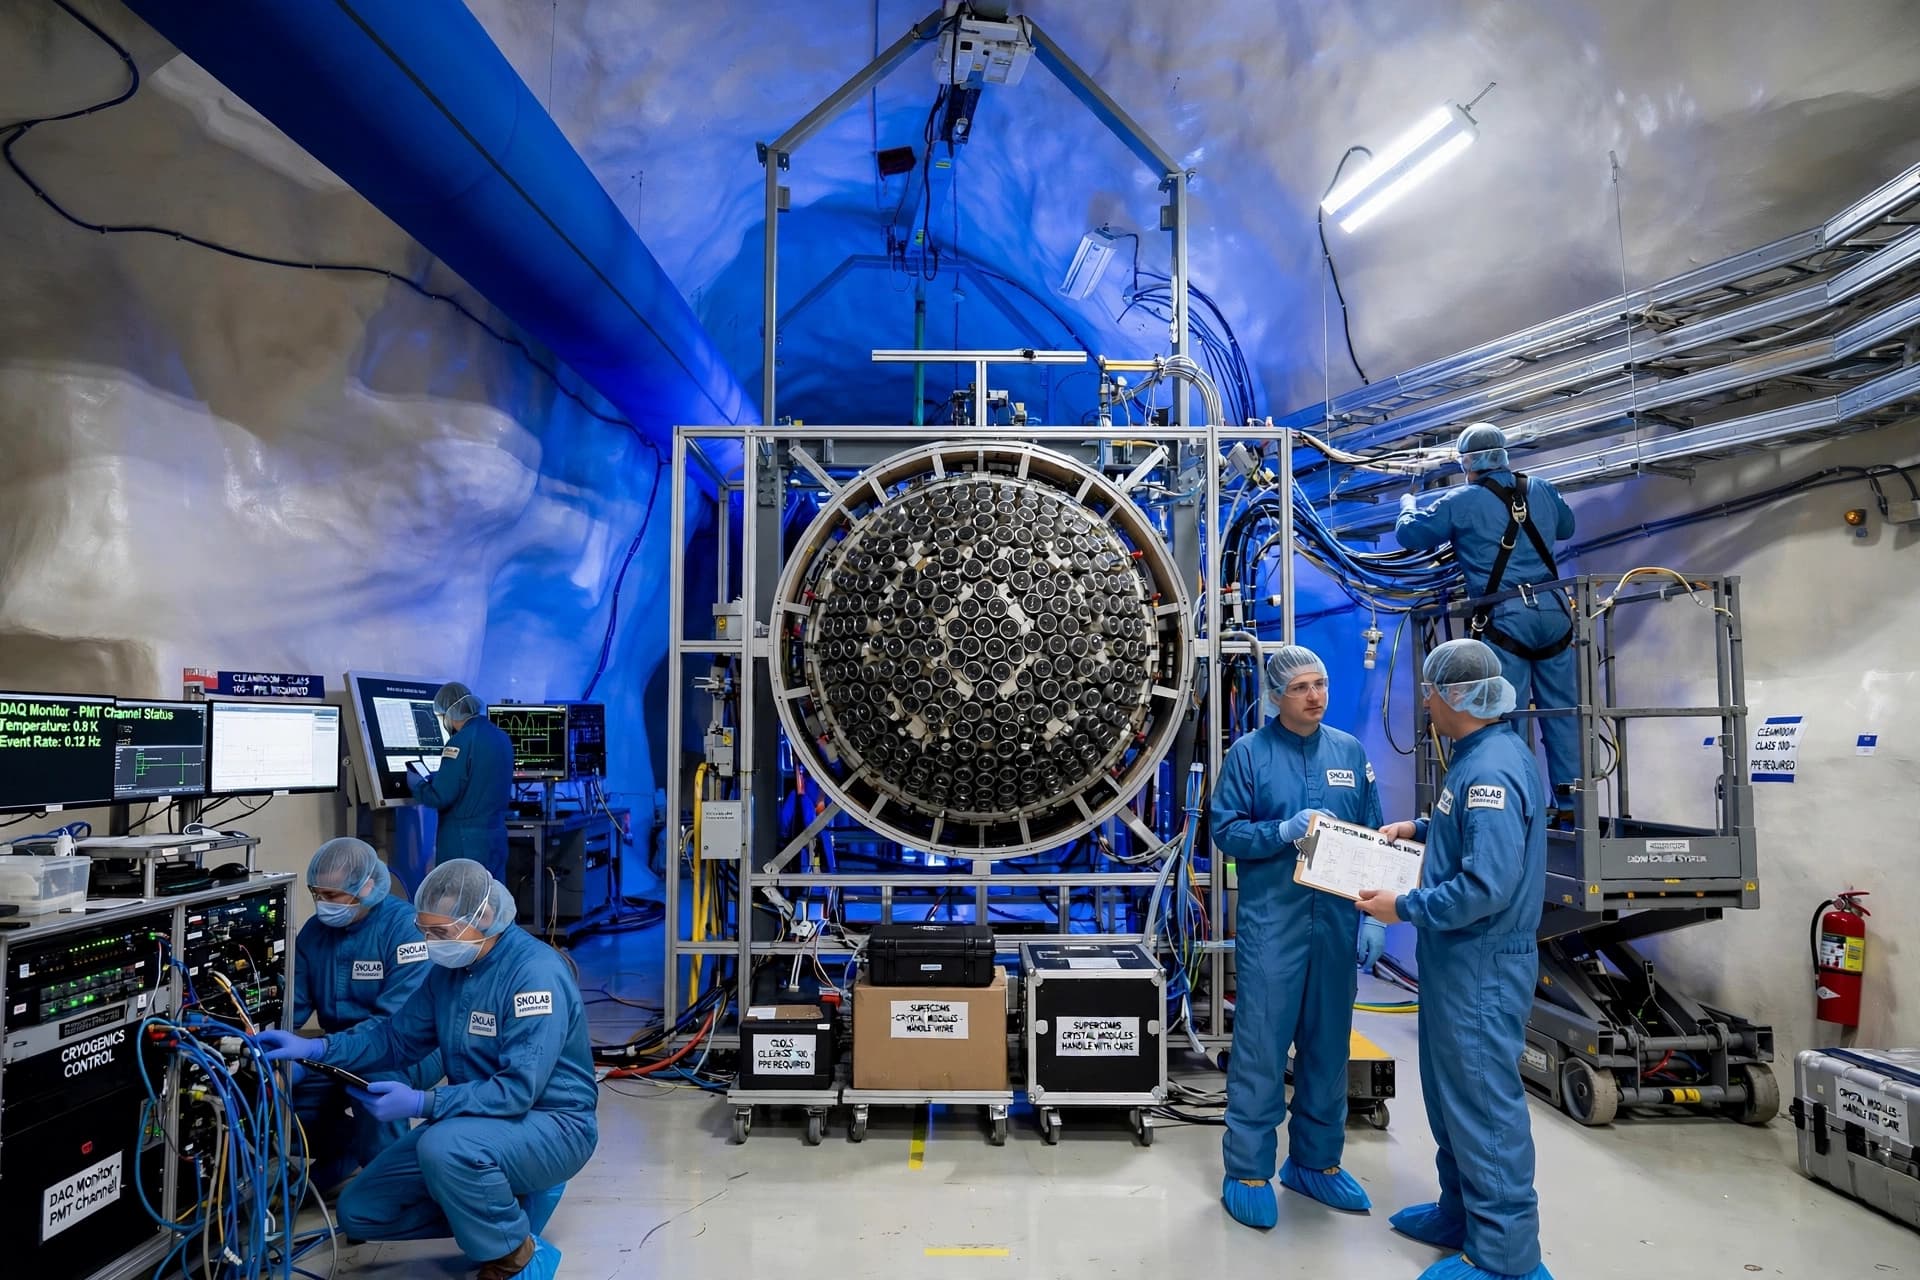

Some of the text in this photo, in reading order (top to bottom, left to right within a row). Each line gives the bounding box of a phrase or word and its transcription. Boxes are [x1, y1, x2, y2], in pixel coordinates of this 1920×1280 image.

[0, 703, 27, 716] DAQ
[30, 703, 70, 717] Monitor
[80, 706, 102, 718] PMT
[104, 707, 142, 719] Channel
[144, 708, 174, 720] Status
[0, 718, 98, 734] Temperature: 0.8 K
[0, 735, 101, 748] Event Rate: 0.12 Hz
[1470, 787, 1502, 799] SNOLAB
[354, 963, 382, 972] SNOLAB
[516, 995, 550, 1007] SNOLAB
[472, 1014, 495, 1027] SNOLAB
[61, 1029, 125, 1062] CRYOGENICS
[1114, 1041, 1134, 1050] CARE
[64, 1049, 115, 1078] CONTROL
[50, 1184, 74, 1207] DAQ
[77, 1164, 114, 1193] Monitor
[50, 1176, 117, 1226] PMT Channel
